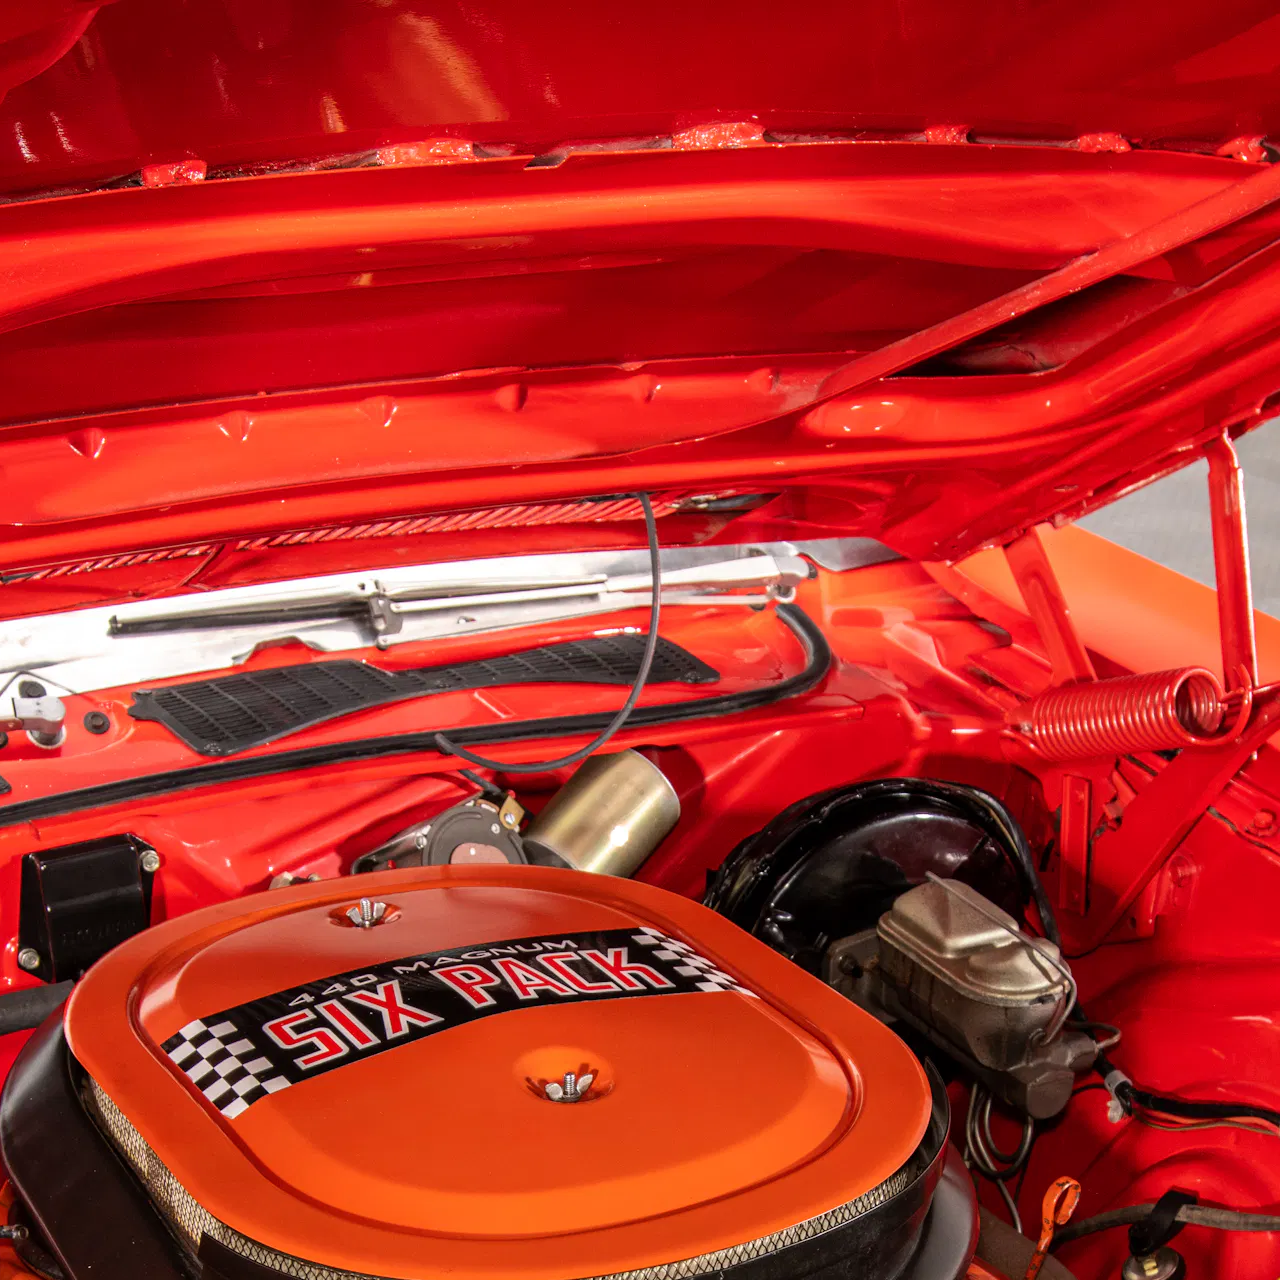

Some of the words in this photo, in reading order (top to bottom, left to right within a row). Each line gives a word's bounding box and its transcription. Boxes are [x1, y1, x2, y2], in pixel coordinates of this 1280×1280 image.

[260, 978, 446, 1074] SIX
[429, 946, 677, 1012] PACK
[286, 972, 379, 1008] 440
[391, 937, 580, 974] MAGNUM
